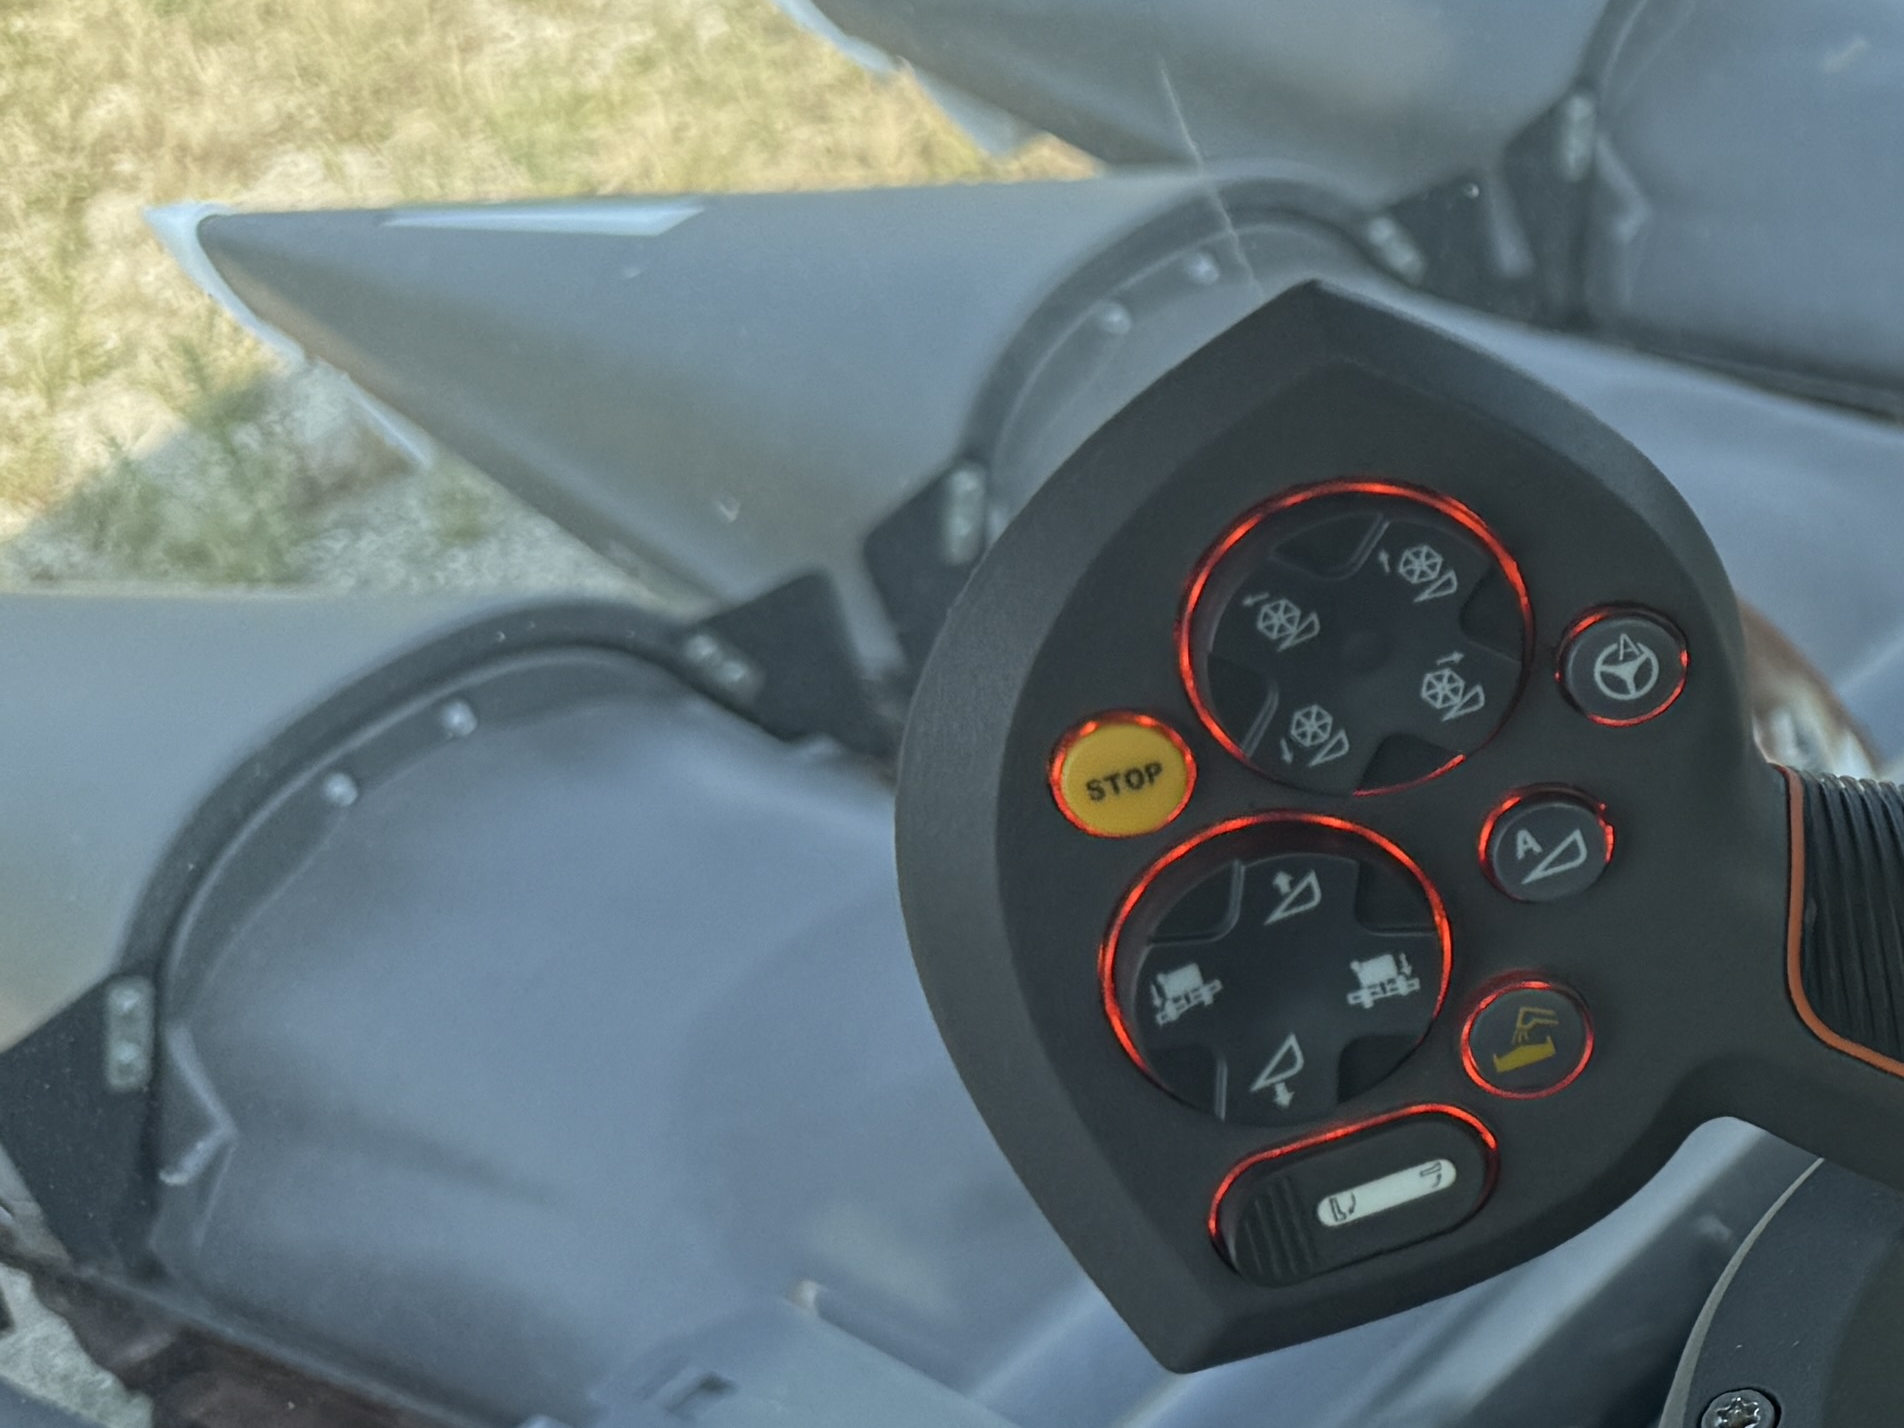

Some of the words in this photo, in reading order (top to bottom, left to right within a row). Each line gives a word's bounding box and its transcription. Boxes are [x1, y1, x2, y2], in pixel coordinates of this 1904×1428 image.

[1618, 632, 1641, 661] A
[1086, 761, 1163, 802] STOP
[1516, 829, 1543, 860] A
